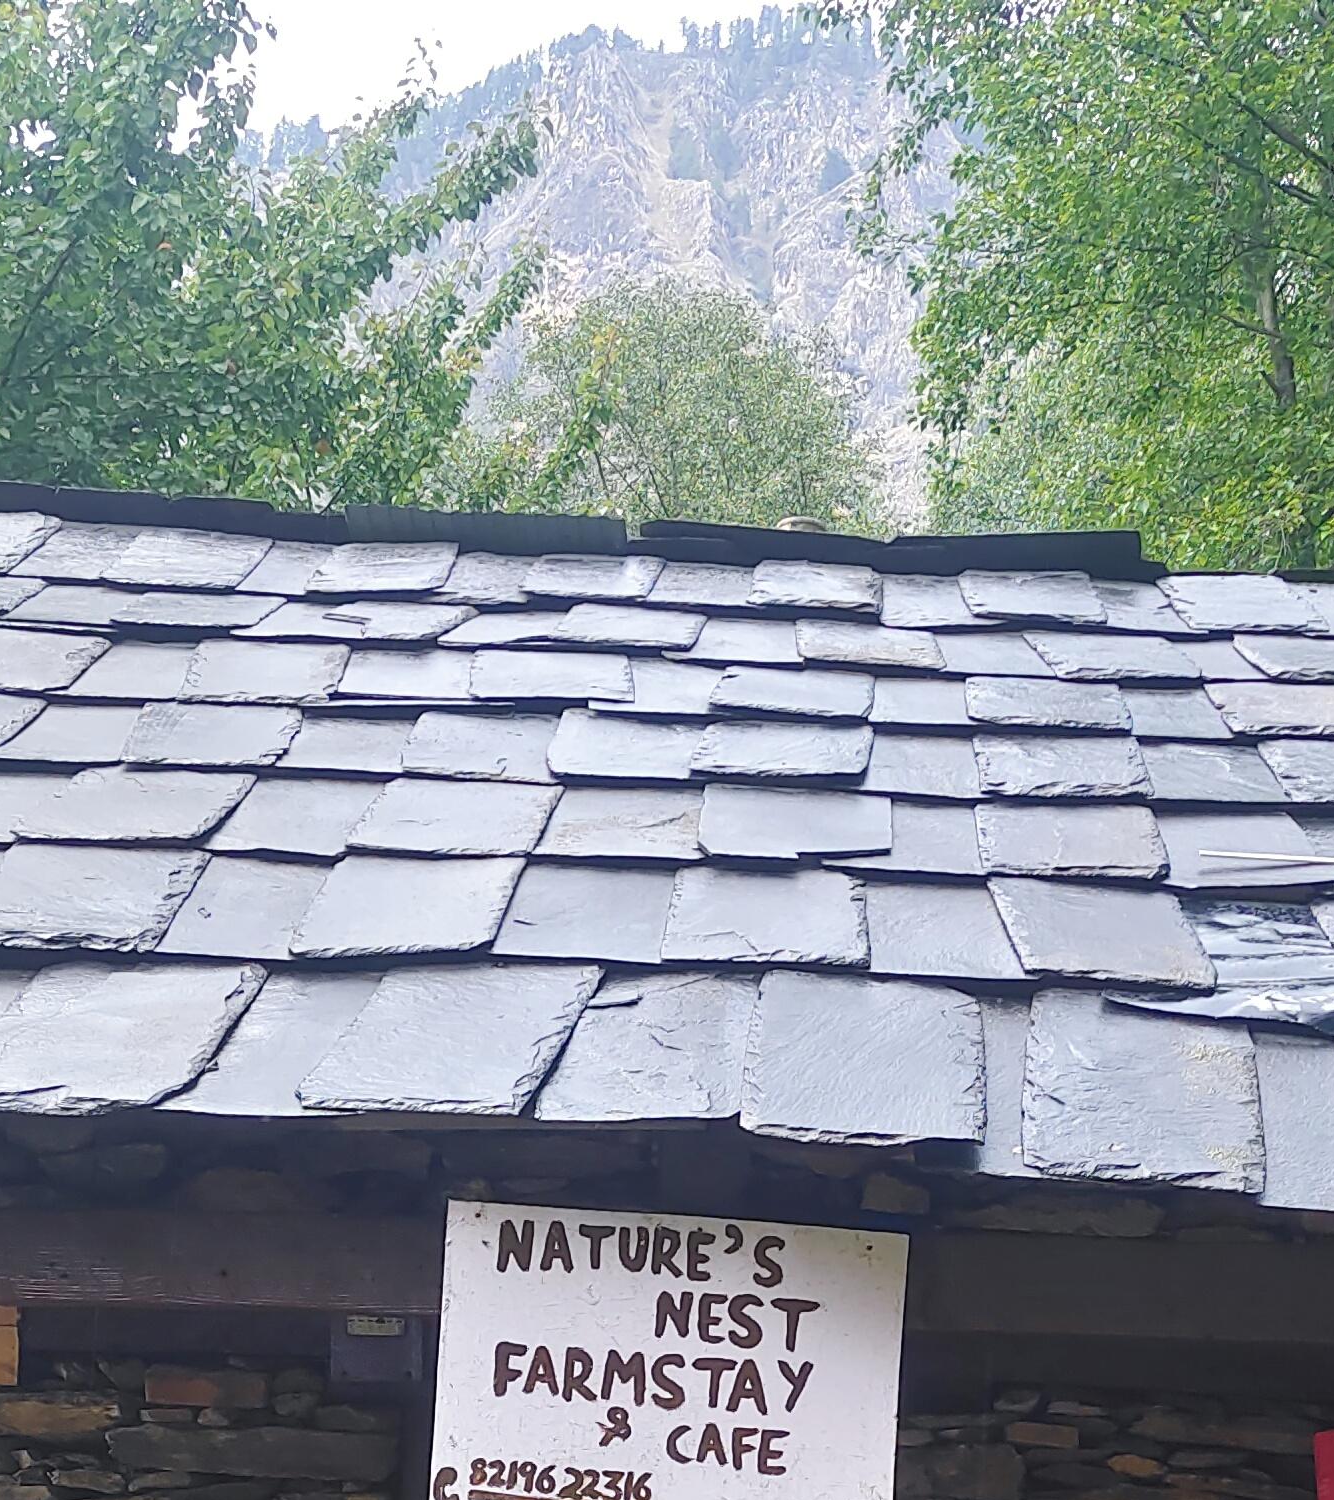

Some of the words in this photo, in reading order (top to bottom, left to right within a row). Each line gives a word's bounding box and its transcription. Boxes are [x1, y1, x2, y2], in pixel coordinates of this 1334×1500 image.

[496, 1219, 786, 1288] NATURE'S
[654, 1290, 821, 1353] NEST
[492, 1340, 814, 1416] FARMSTAY
[597, 1406, 632, 1447] &
[665, 1422, 791, 1476] CAFE
